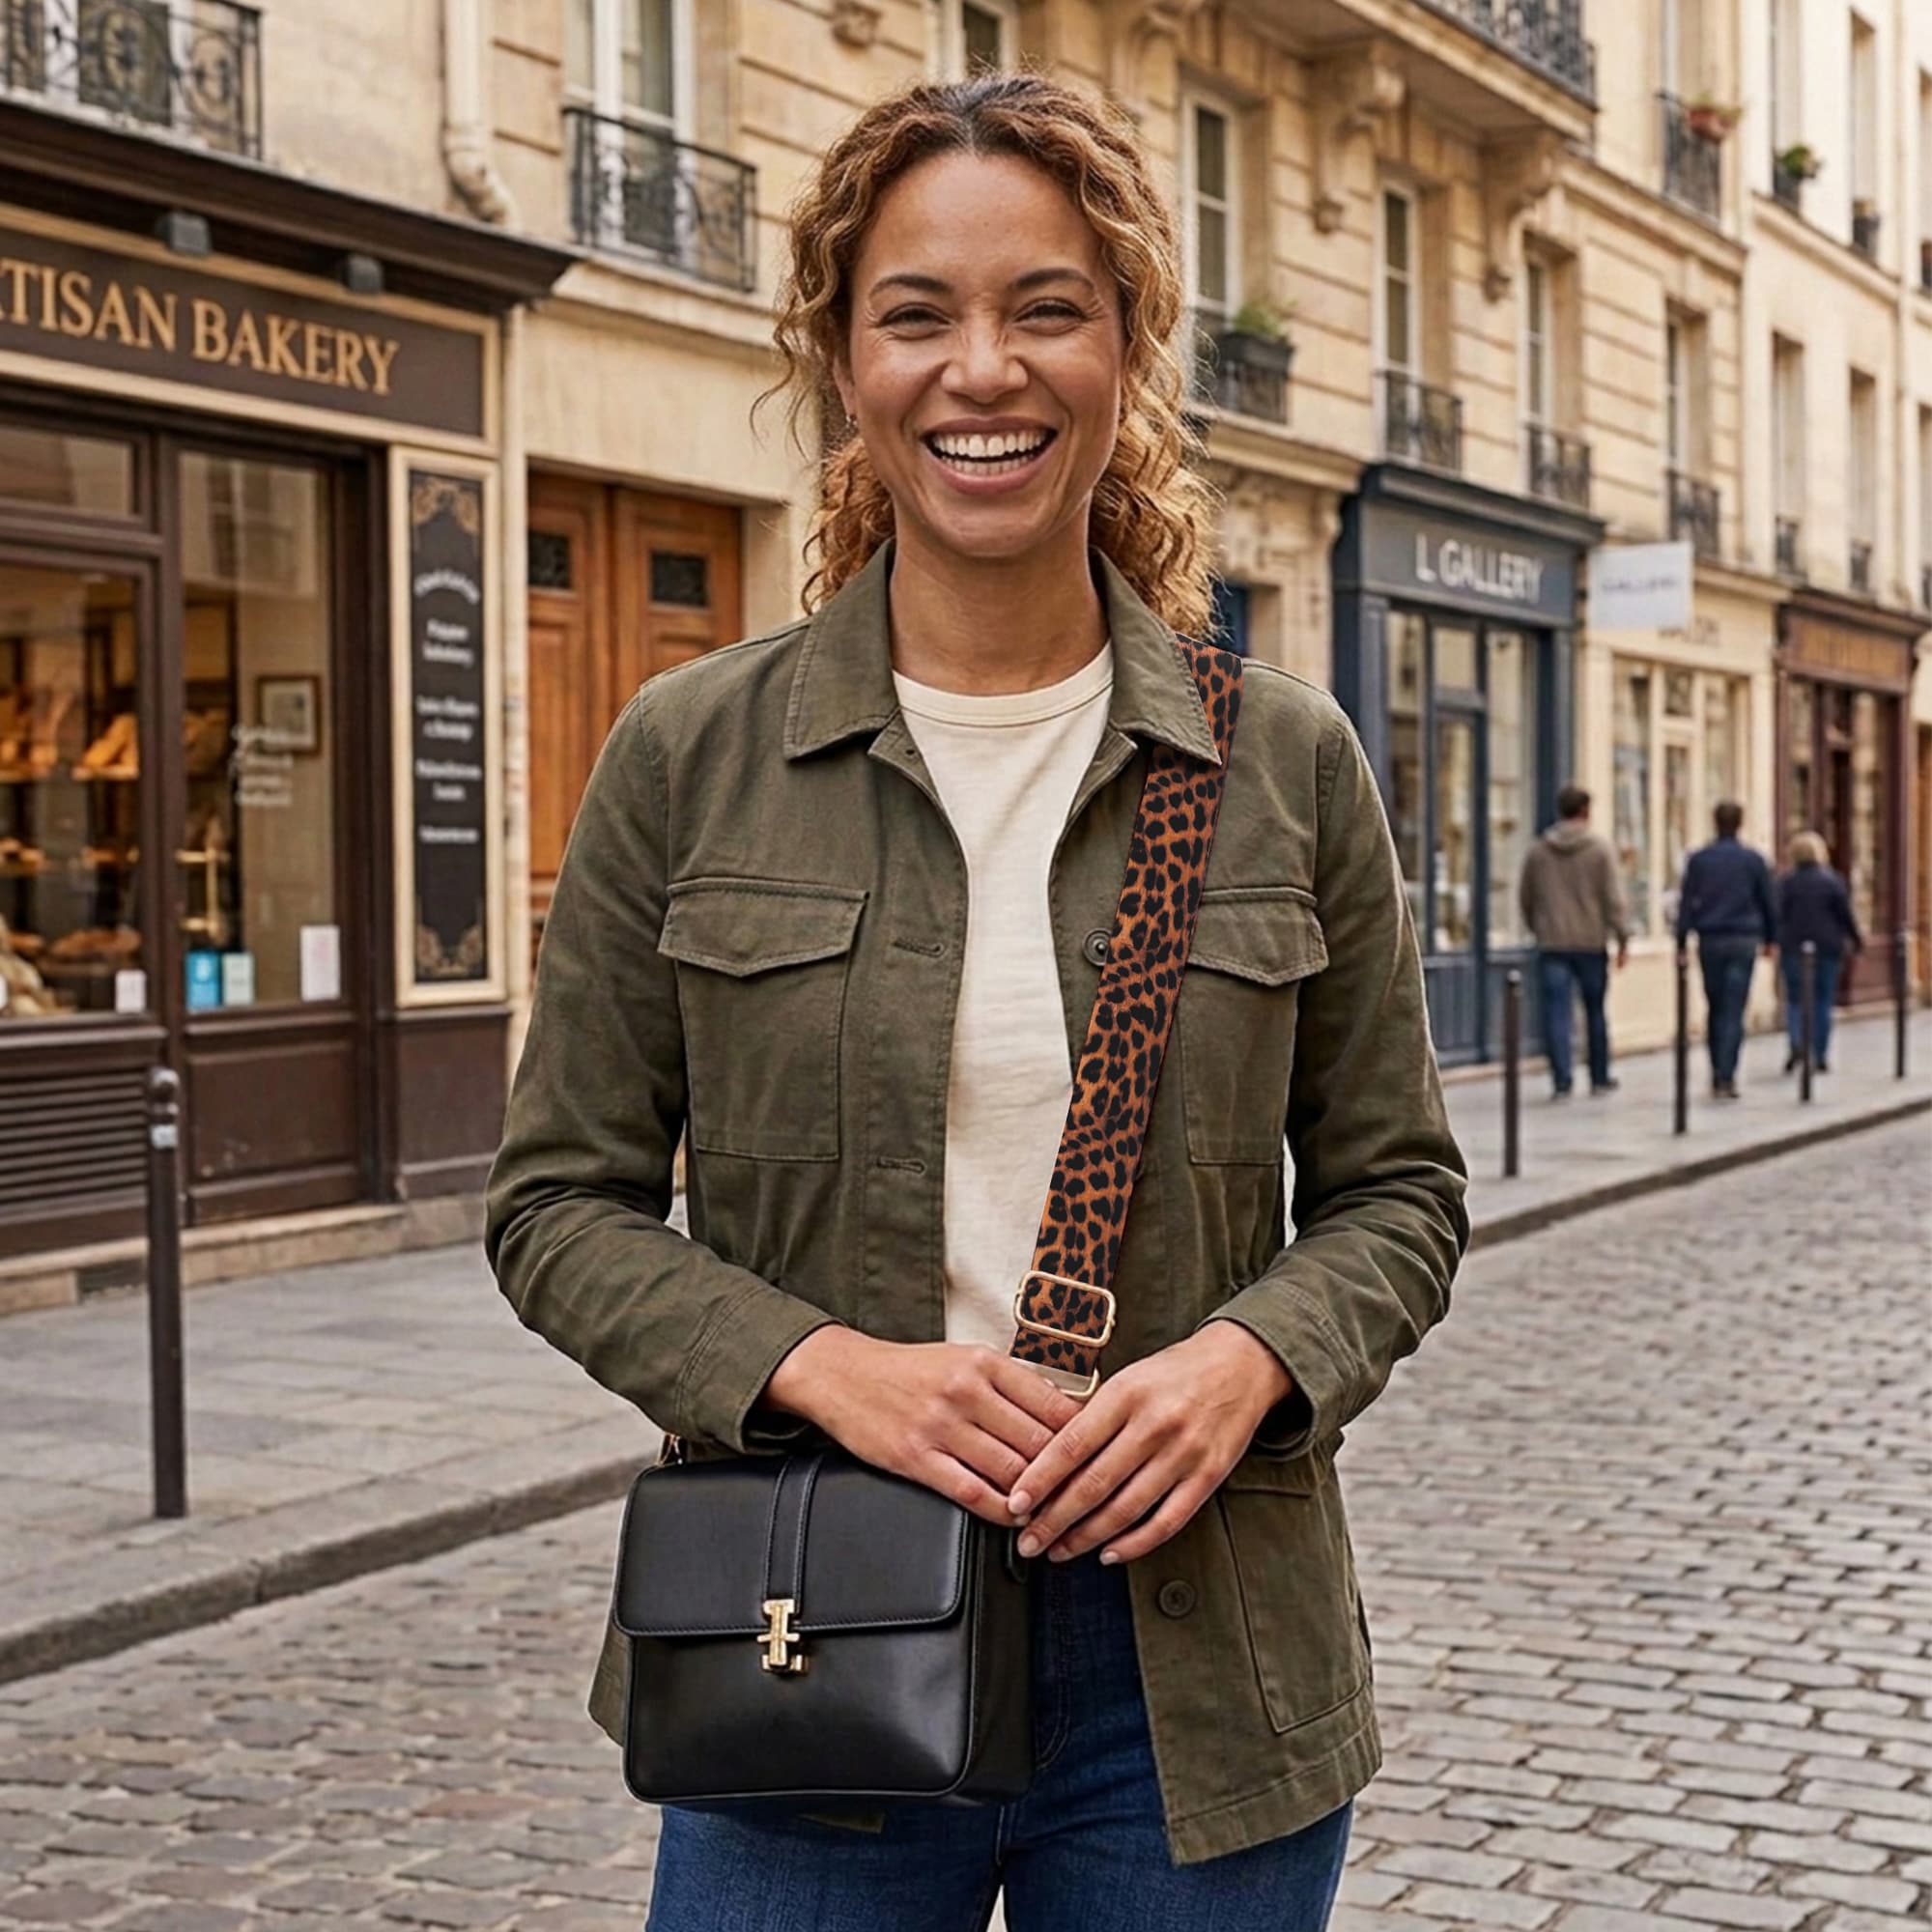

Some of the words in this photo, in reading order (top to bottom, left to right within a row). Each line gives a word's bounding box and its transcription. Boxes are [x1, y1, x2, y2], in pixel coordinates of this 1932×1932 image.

[0, 257, 177, 351] TISAN
[193, 299, 399, 394] BAKERY
[1415, 532, 1436, 582] L
[1439, 539, 1545, 604] GALLERY
